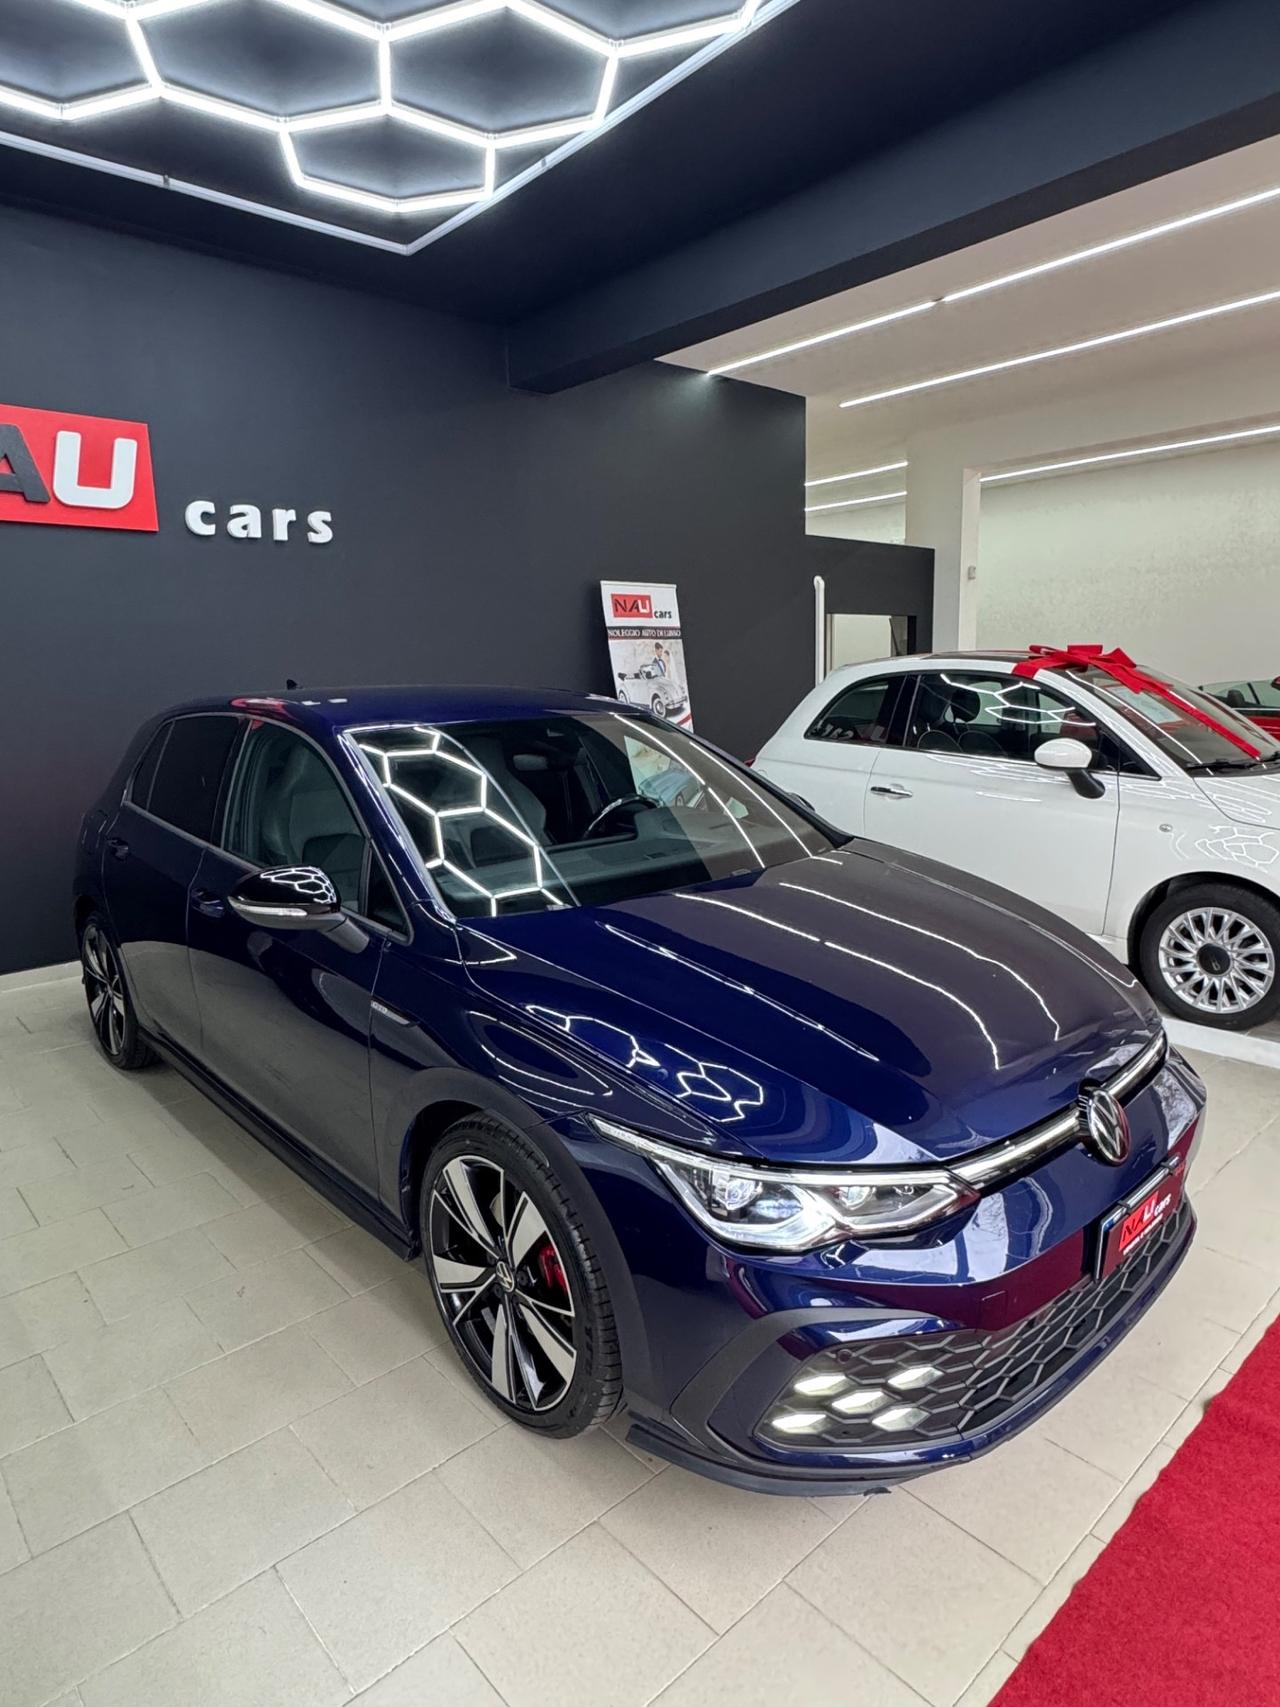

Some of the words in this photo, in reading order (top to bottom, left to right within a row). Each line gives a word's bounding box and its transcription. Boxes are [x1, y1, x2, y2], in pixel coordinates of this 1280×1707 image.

[184, 499, 334, 544] cars
[614, 599, 650, 613] NAU
[653, 610, 673, 619] cars
